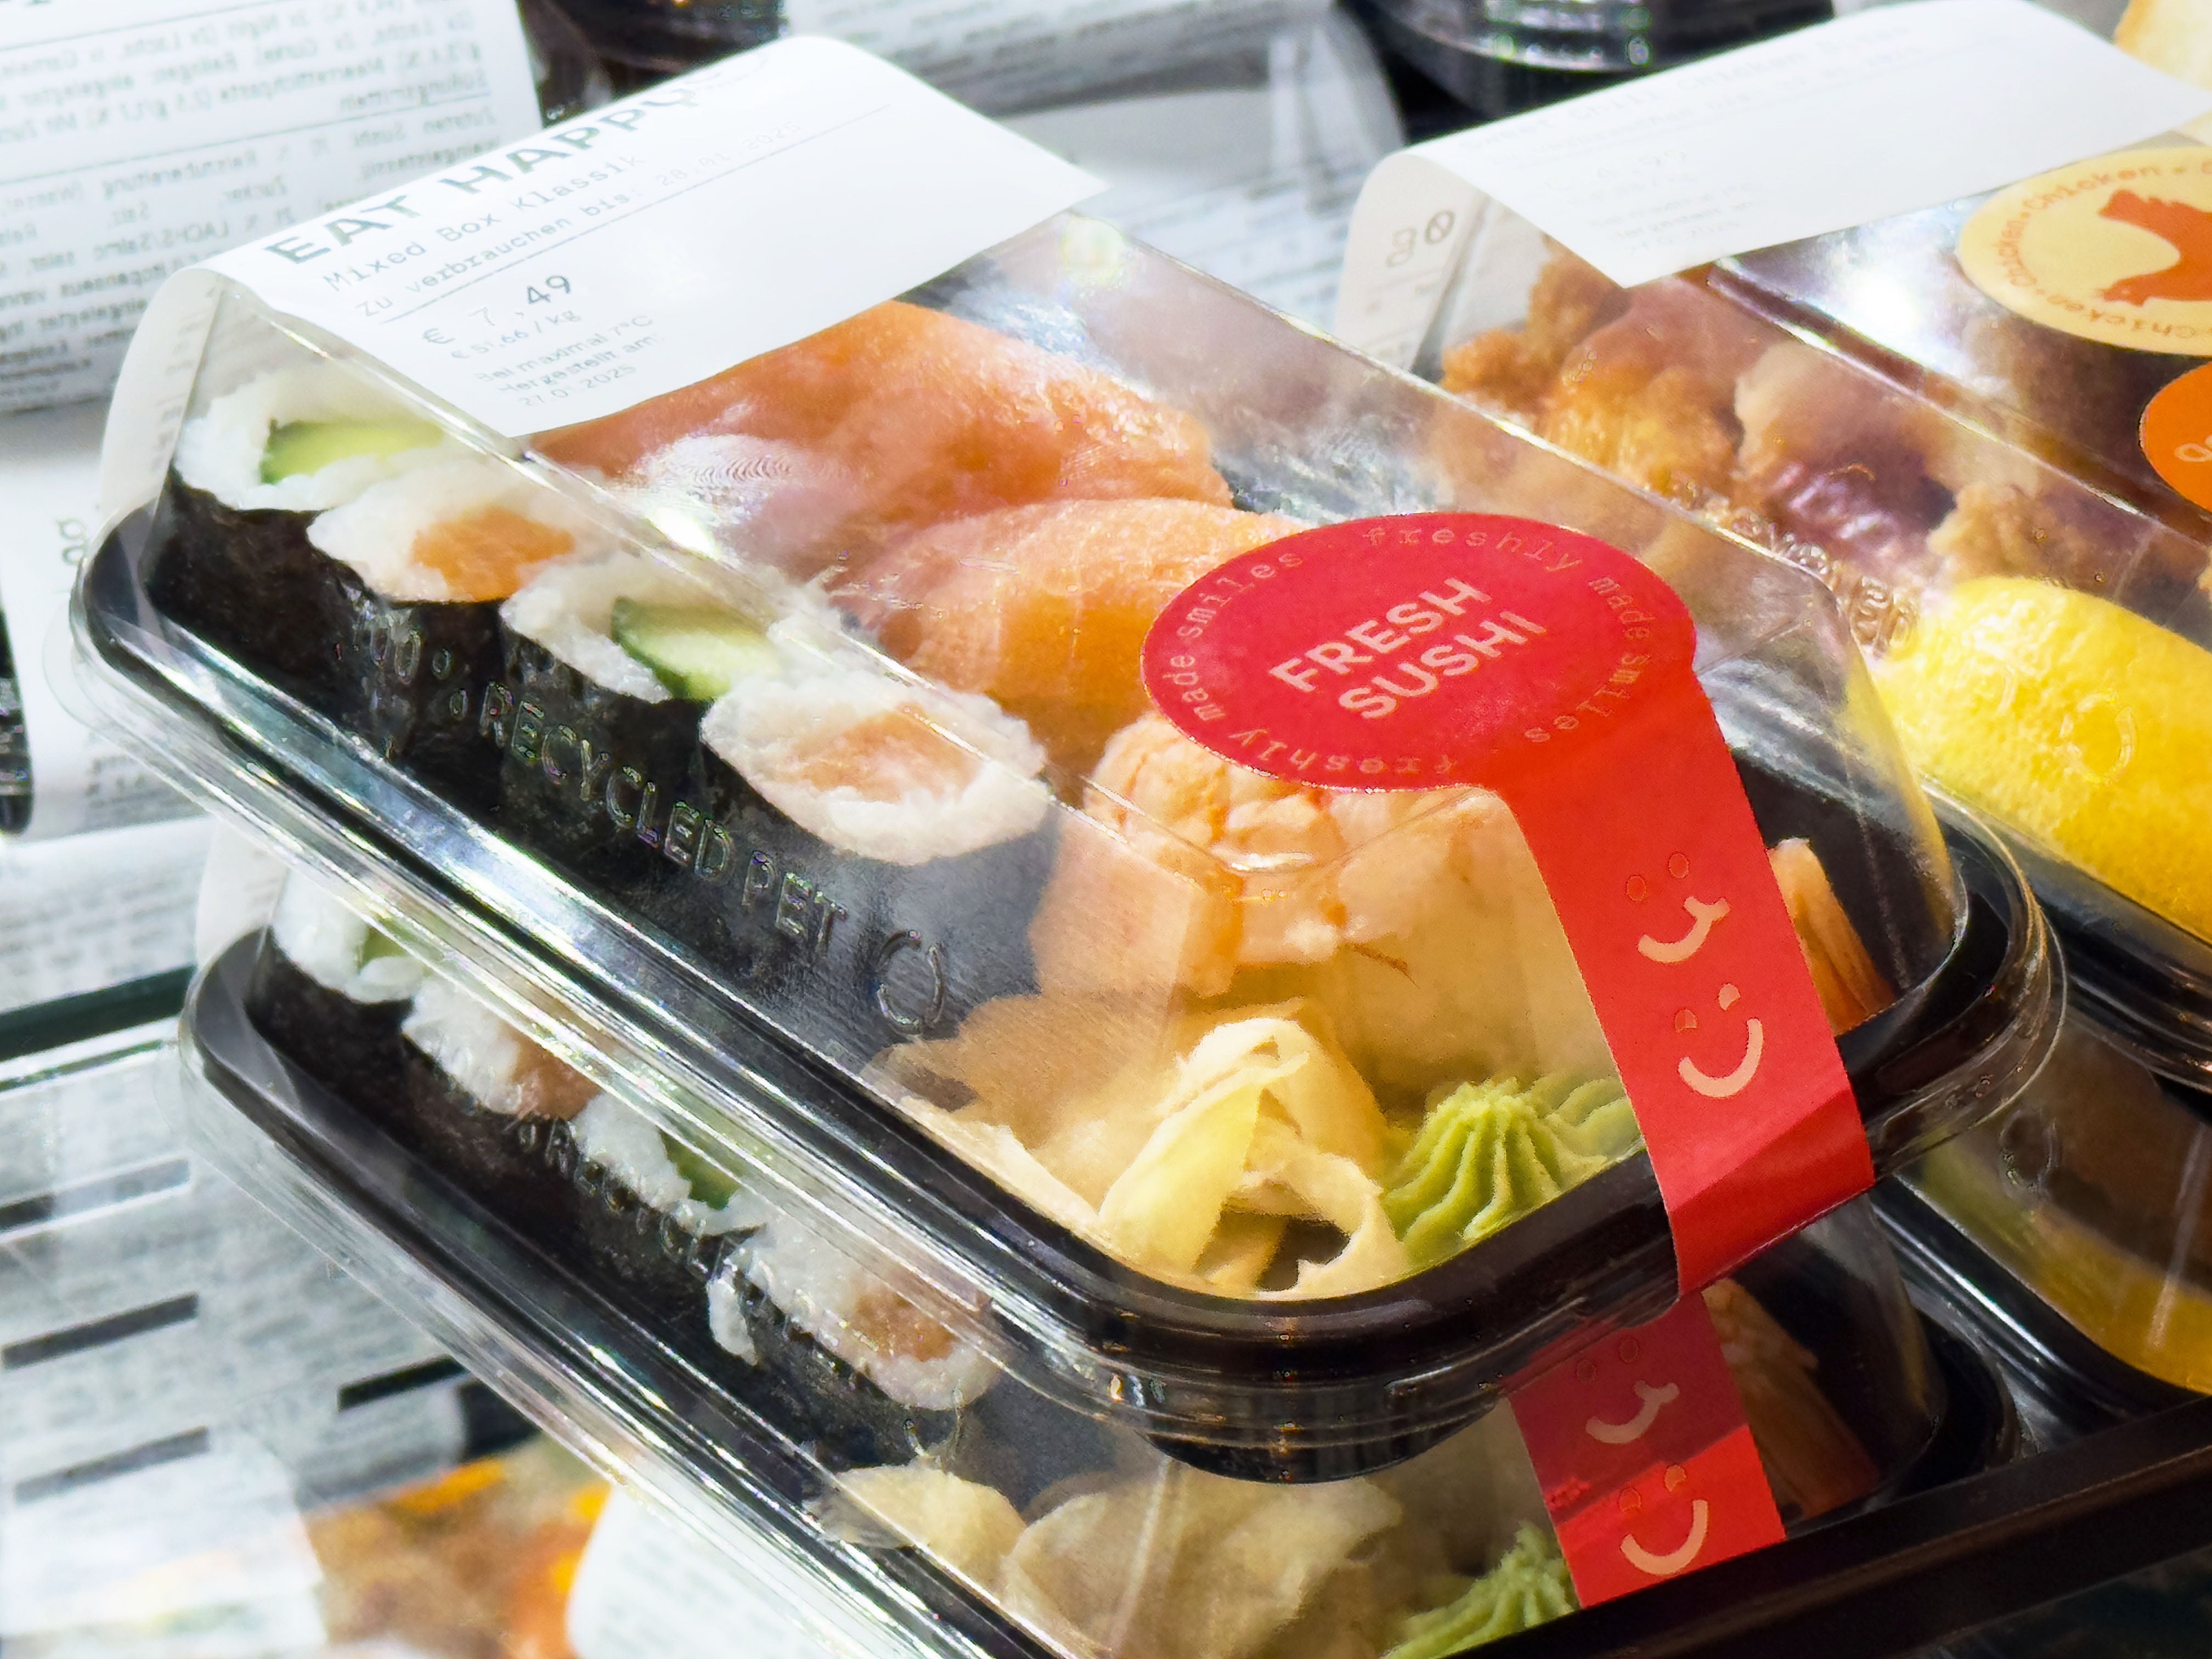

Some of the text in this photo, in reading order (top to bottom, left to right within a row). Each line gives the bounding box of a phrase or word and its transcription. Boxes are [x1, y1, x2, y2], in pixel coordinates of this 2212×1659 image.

[262, 88, 698, 264] EAT HAPPY
[323, 154, 646, 291] Mixed Box Klassik
[354, 296, 393, 317] Zu
[405, 217, 572, 293] verbrauchen
[422, 328, 455, 345] €
[516, 332, 609, 373] maximal
[1161, 551, 1456, 776] freshly made smiles
[1269, 577, 1492, 692] FRESH
[1339, 610, 1547, 719] SUSHI
[1363, 527, 1657, 744] freshly made smiles
[478, 680, 735, 879] RECYCLED
[740, 849, 849, 959] PET
